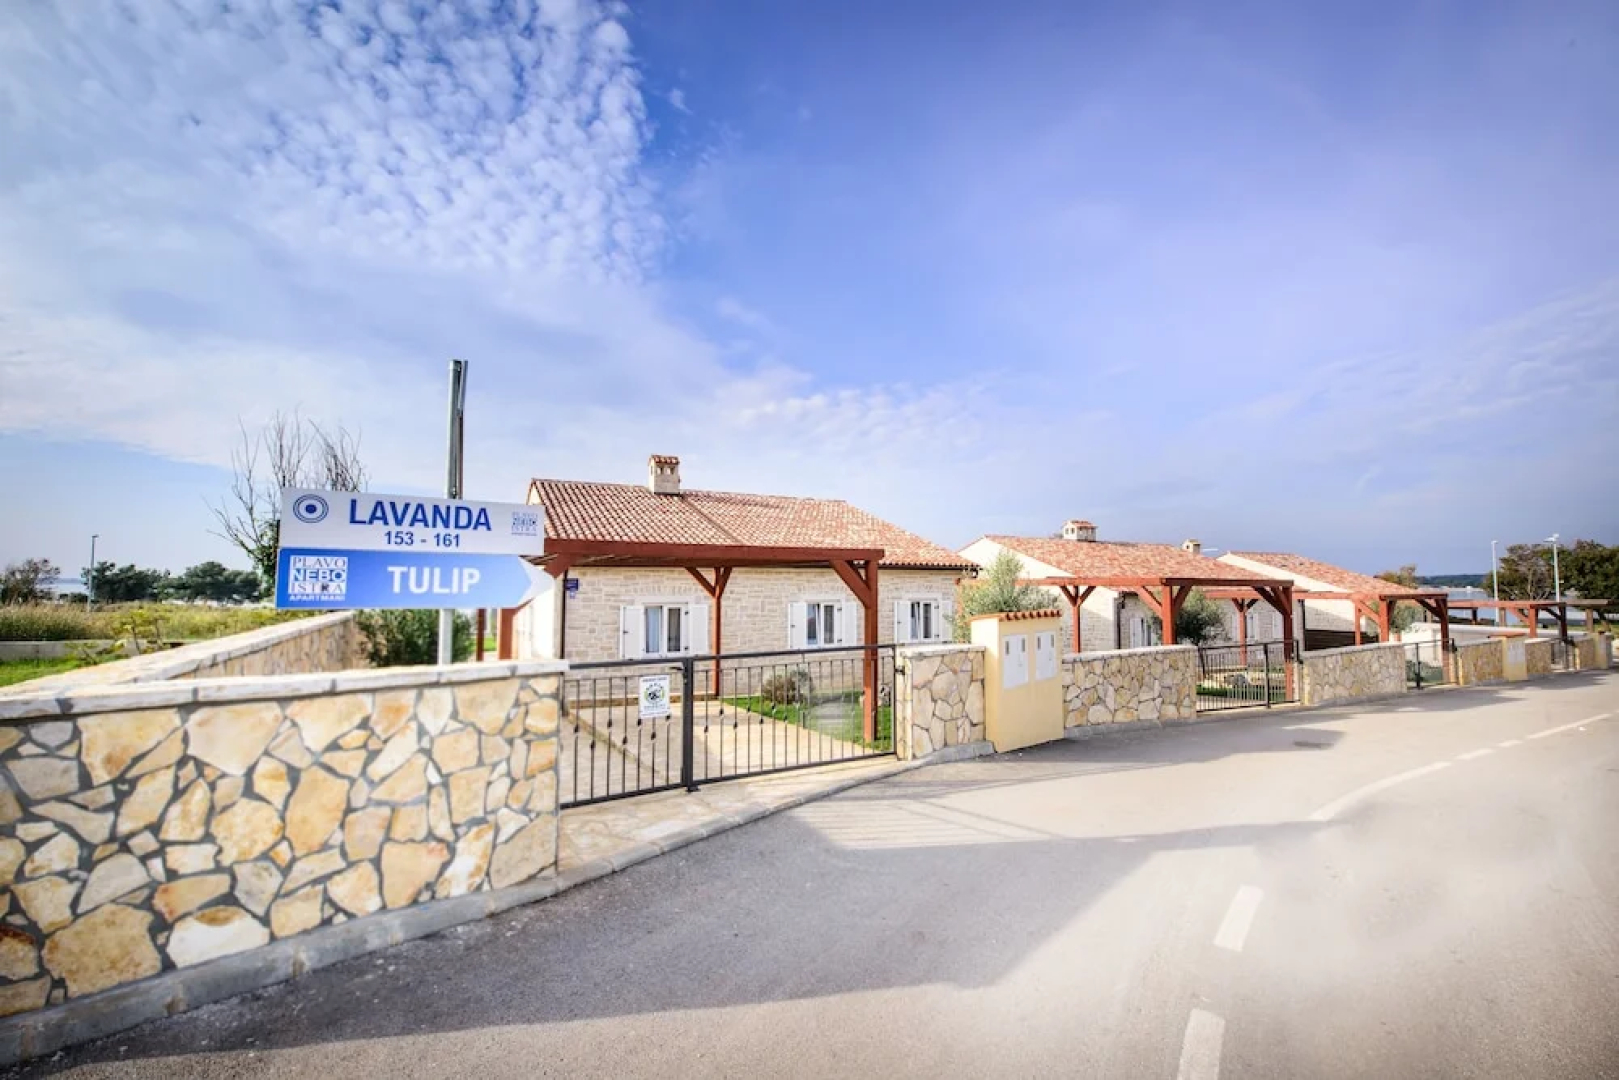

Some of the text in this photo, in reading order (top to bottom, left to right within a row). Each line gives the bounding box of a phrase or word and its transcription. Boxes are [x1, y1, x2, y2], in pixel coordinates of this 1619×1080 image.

[350, 499, 492, 531] LAVANDA
[384, 530, 414, 546] 153
[433, 532, 460, 547] 161
[292, 556, 346, 568] PLAVO
[292, 568, 347, 582] NEBO
[387, 566, 481, 594] TULIP
[291, 582, 344, 593] ISTRA
